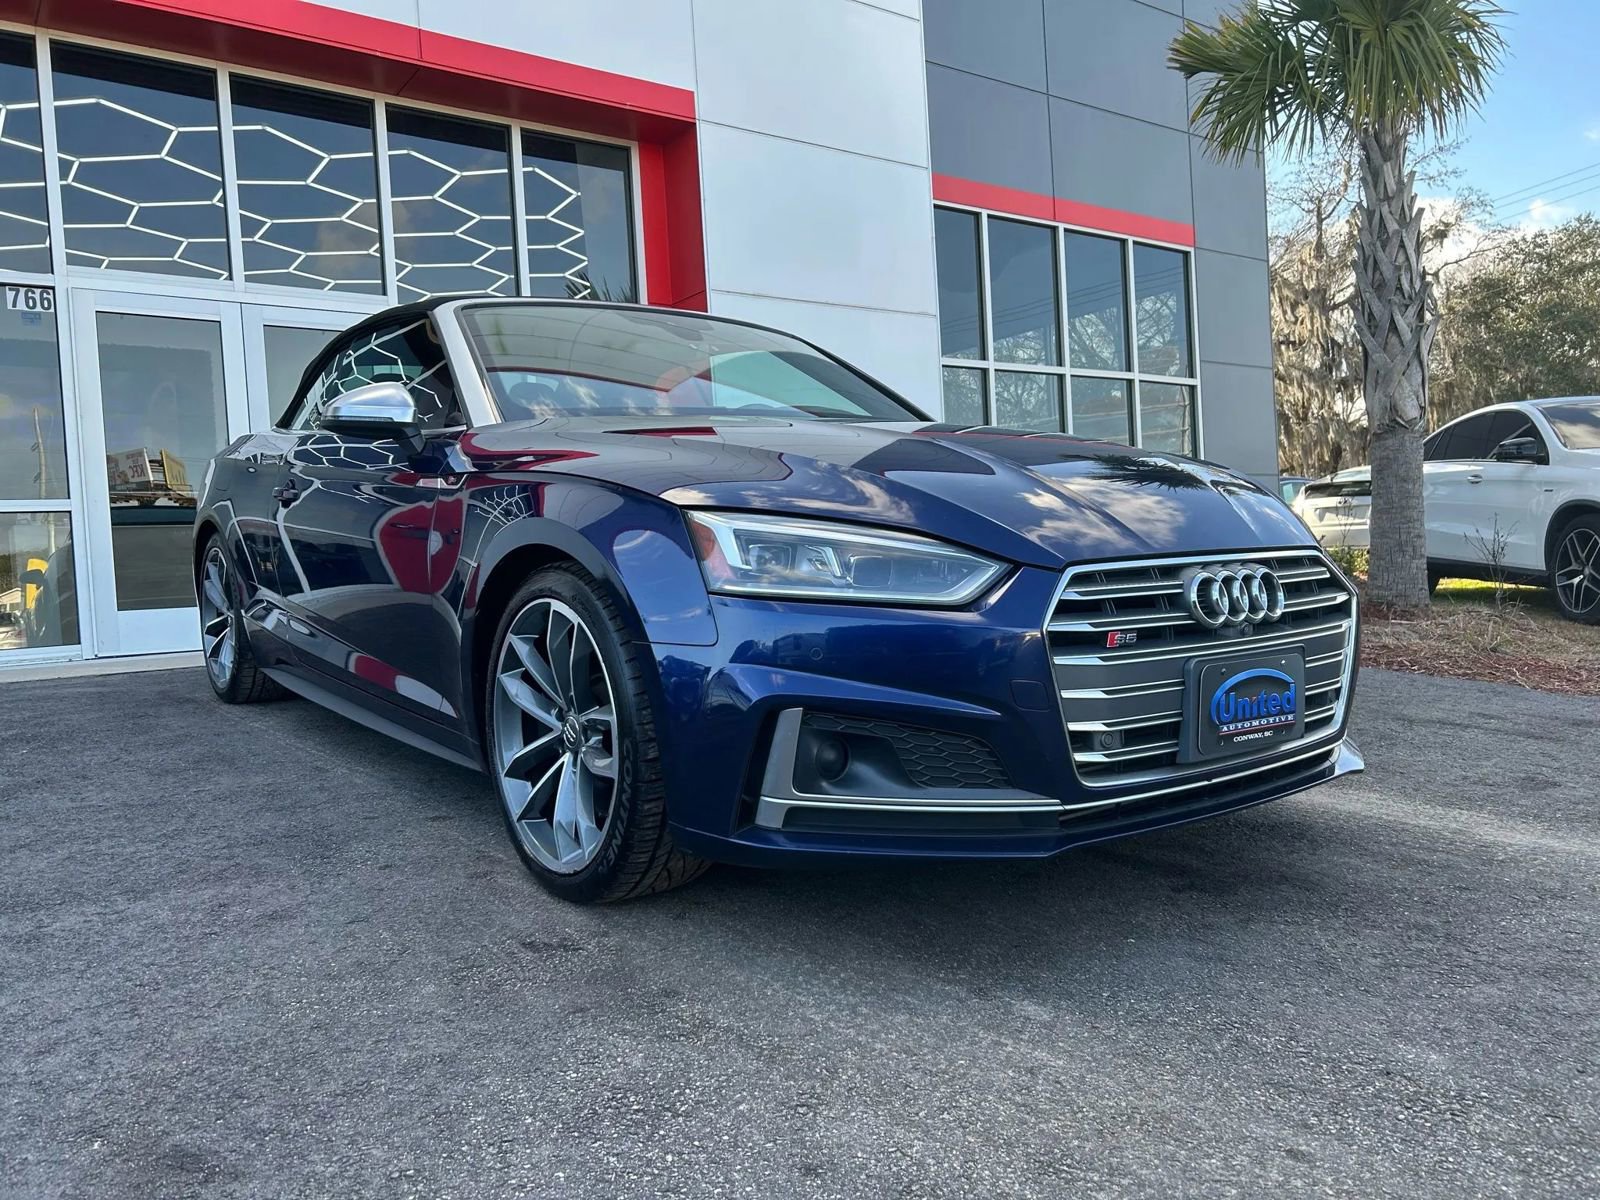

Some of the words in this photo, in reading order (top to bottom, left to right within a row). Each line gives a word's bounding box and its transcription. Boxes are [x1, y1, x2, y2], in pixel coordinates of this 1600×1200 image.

[8, 287, 52, 311] 766
[1219, 683, 1296, 723] United
[1221, 714, 1295, 732] AUTOMOTIVE
[1233, 732, 1264, 742] CONWAY,
